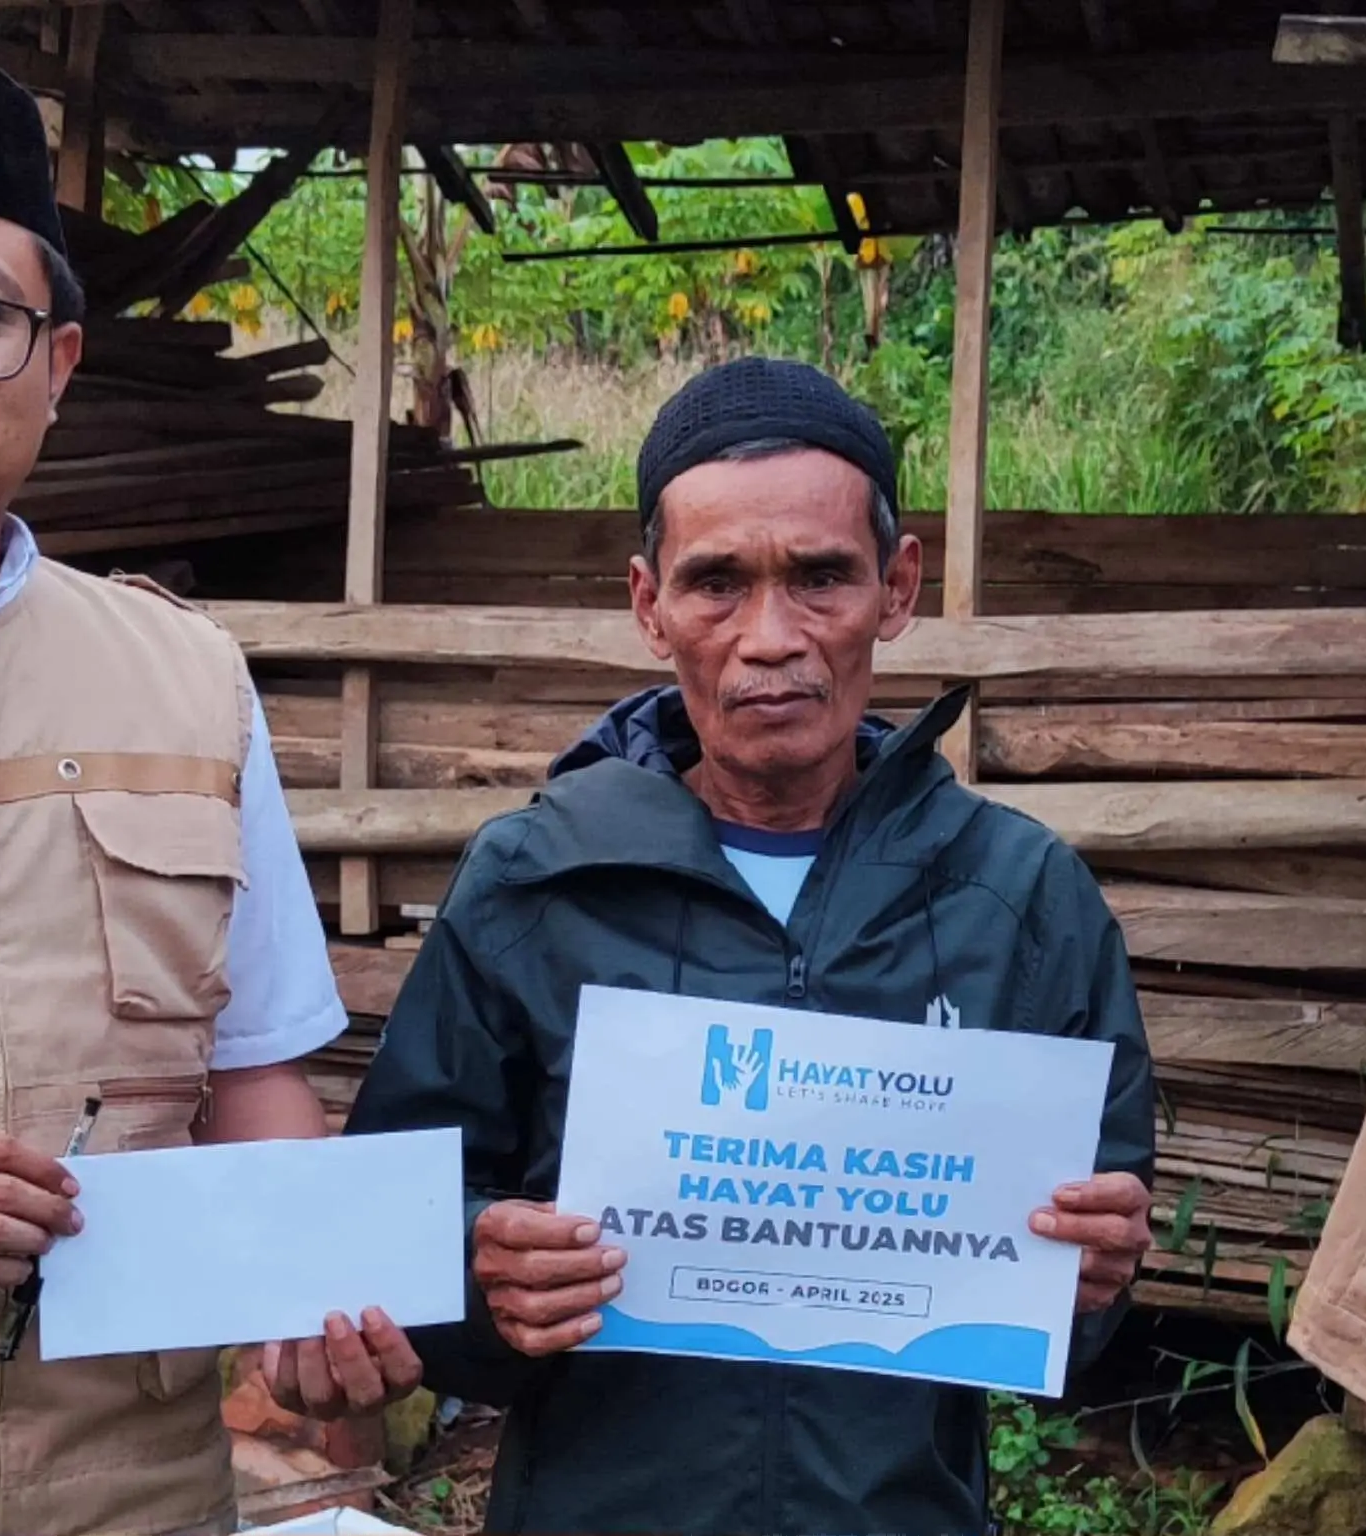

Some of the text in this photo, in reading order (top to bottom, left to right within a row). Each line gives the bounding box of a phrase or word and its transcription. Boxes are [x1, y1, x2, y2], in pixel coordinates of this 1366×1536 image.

[778, 1059, 953, 1096] HAYAT YOLU
[664, 1129, 975, 1183] TERIMA KASIH
[679, 1173, 950, 1218] HAYAT YOLU
[597, 1205, 1019, 1264] ATAS BANTUANNYA
[790, 1285, 851, 1303] APRIL
